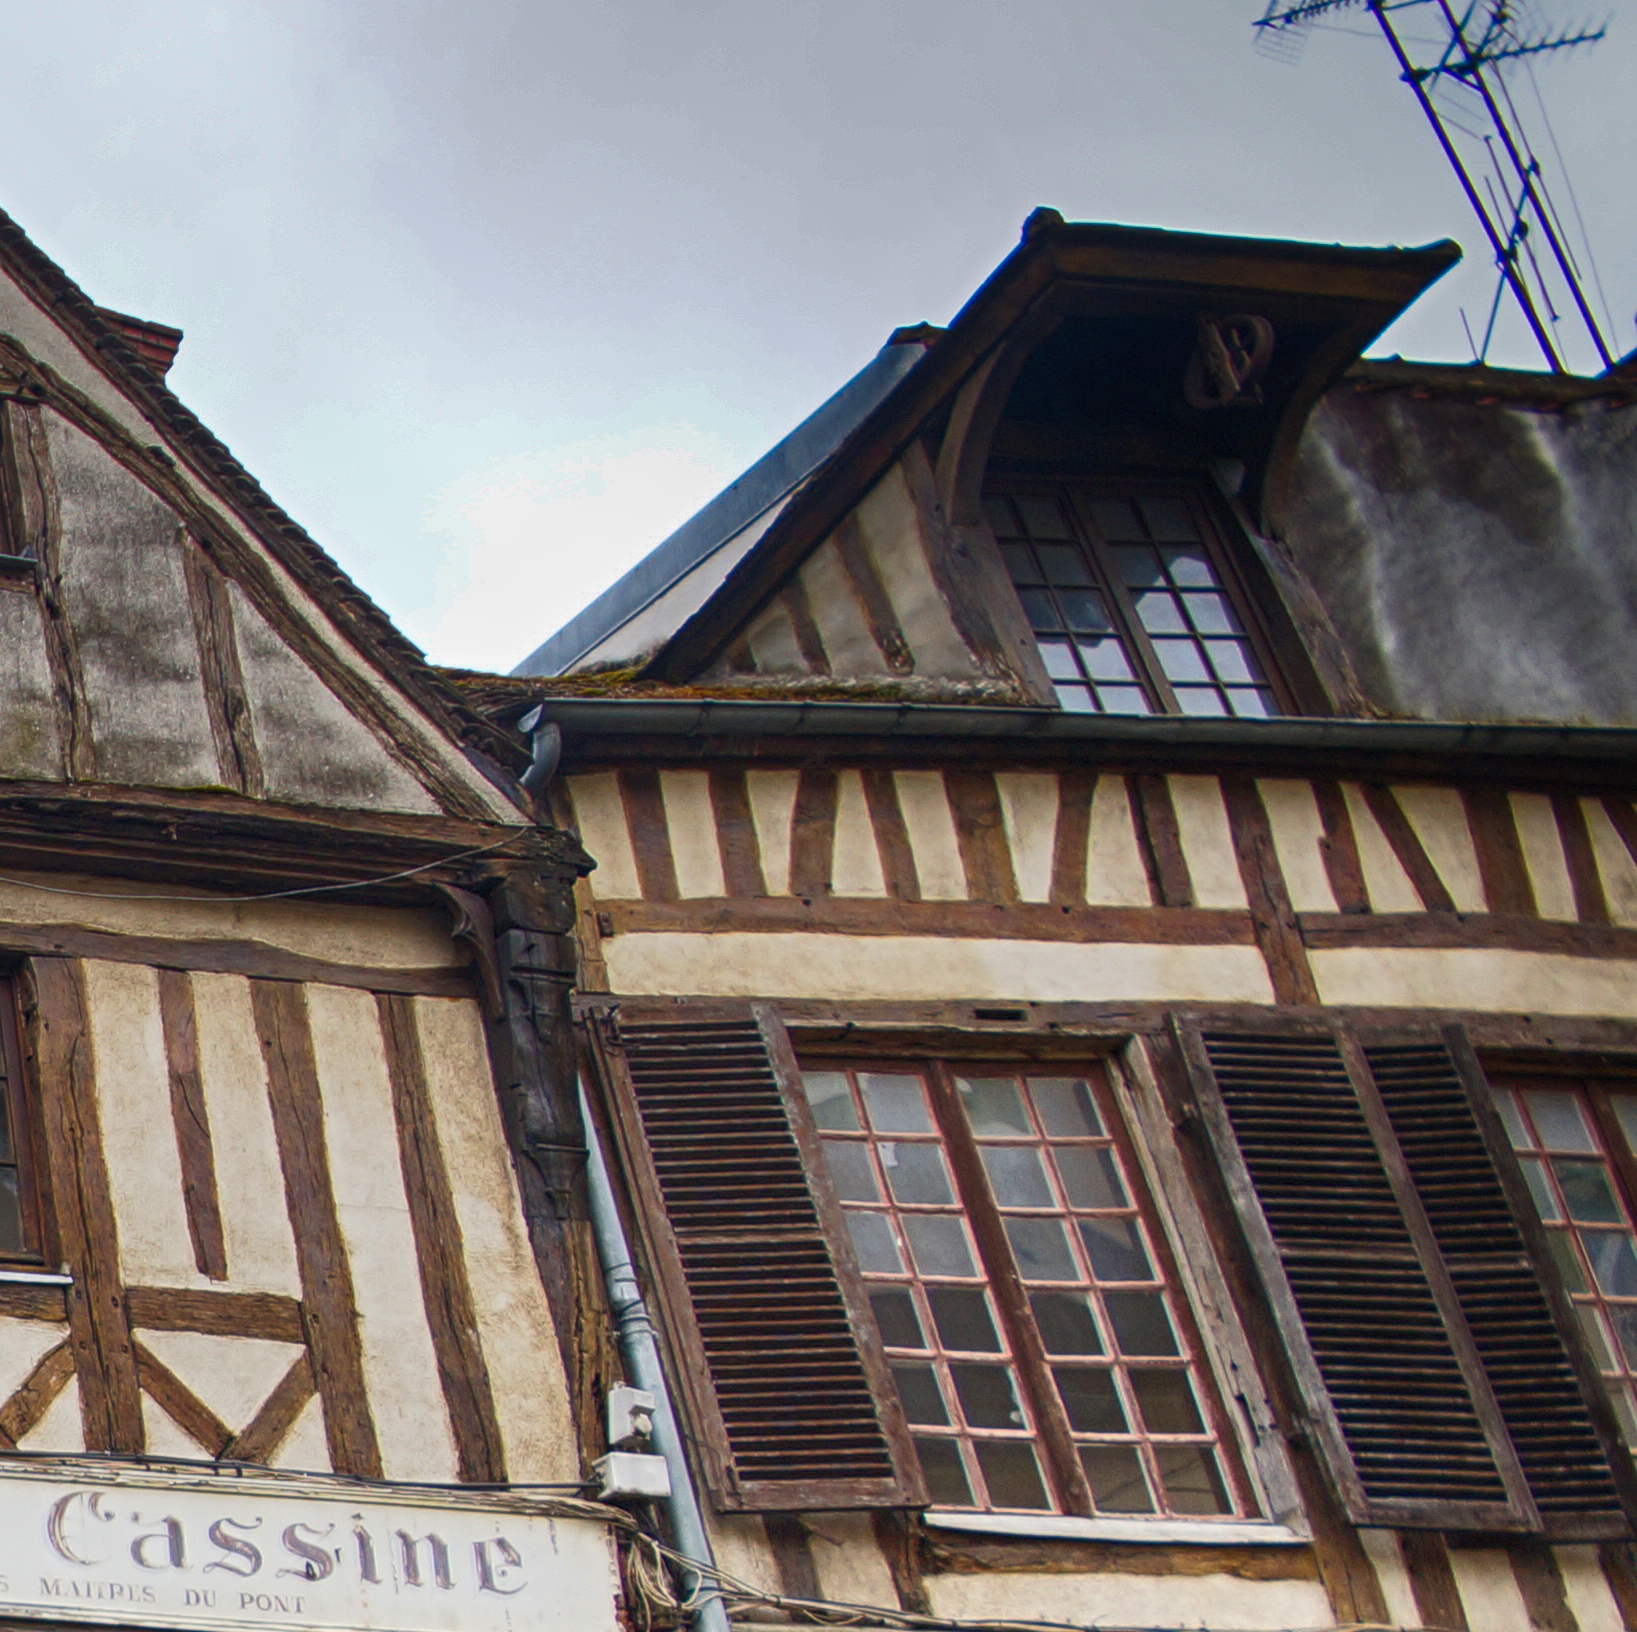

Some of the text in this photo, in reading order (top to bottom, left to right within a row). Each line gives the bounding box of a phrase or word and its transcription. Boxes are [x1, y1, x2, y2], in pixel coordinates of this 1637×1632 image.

[46, 1489, 528, 1596] Cassine
[183, 1588, 217, 1608] DU
[237, 1591, 306, 1614] PONT
